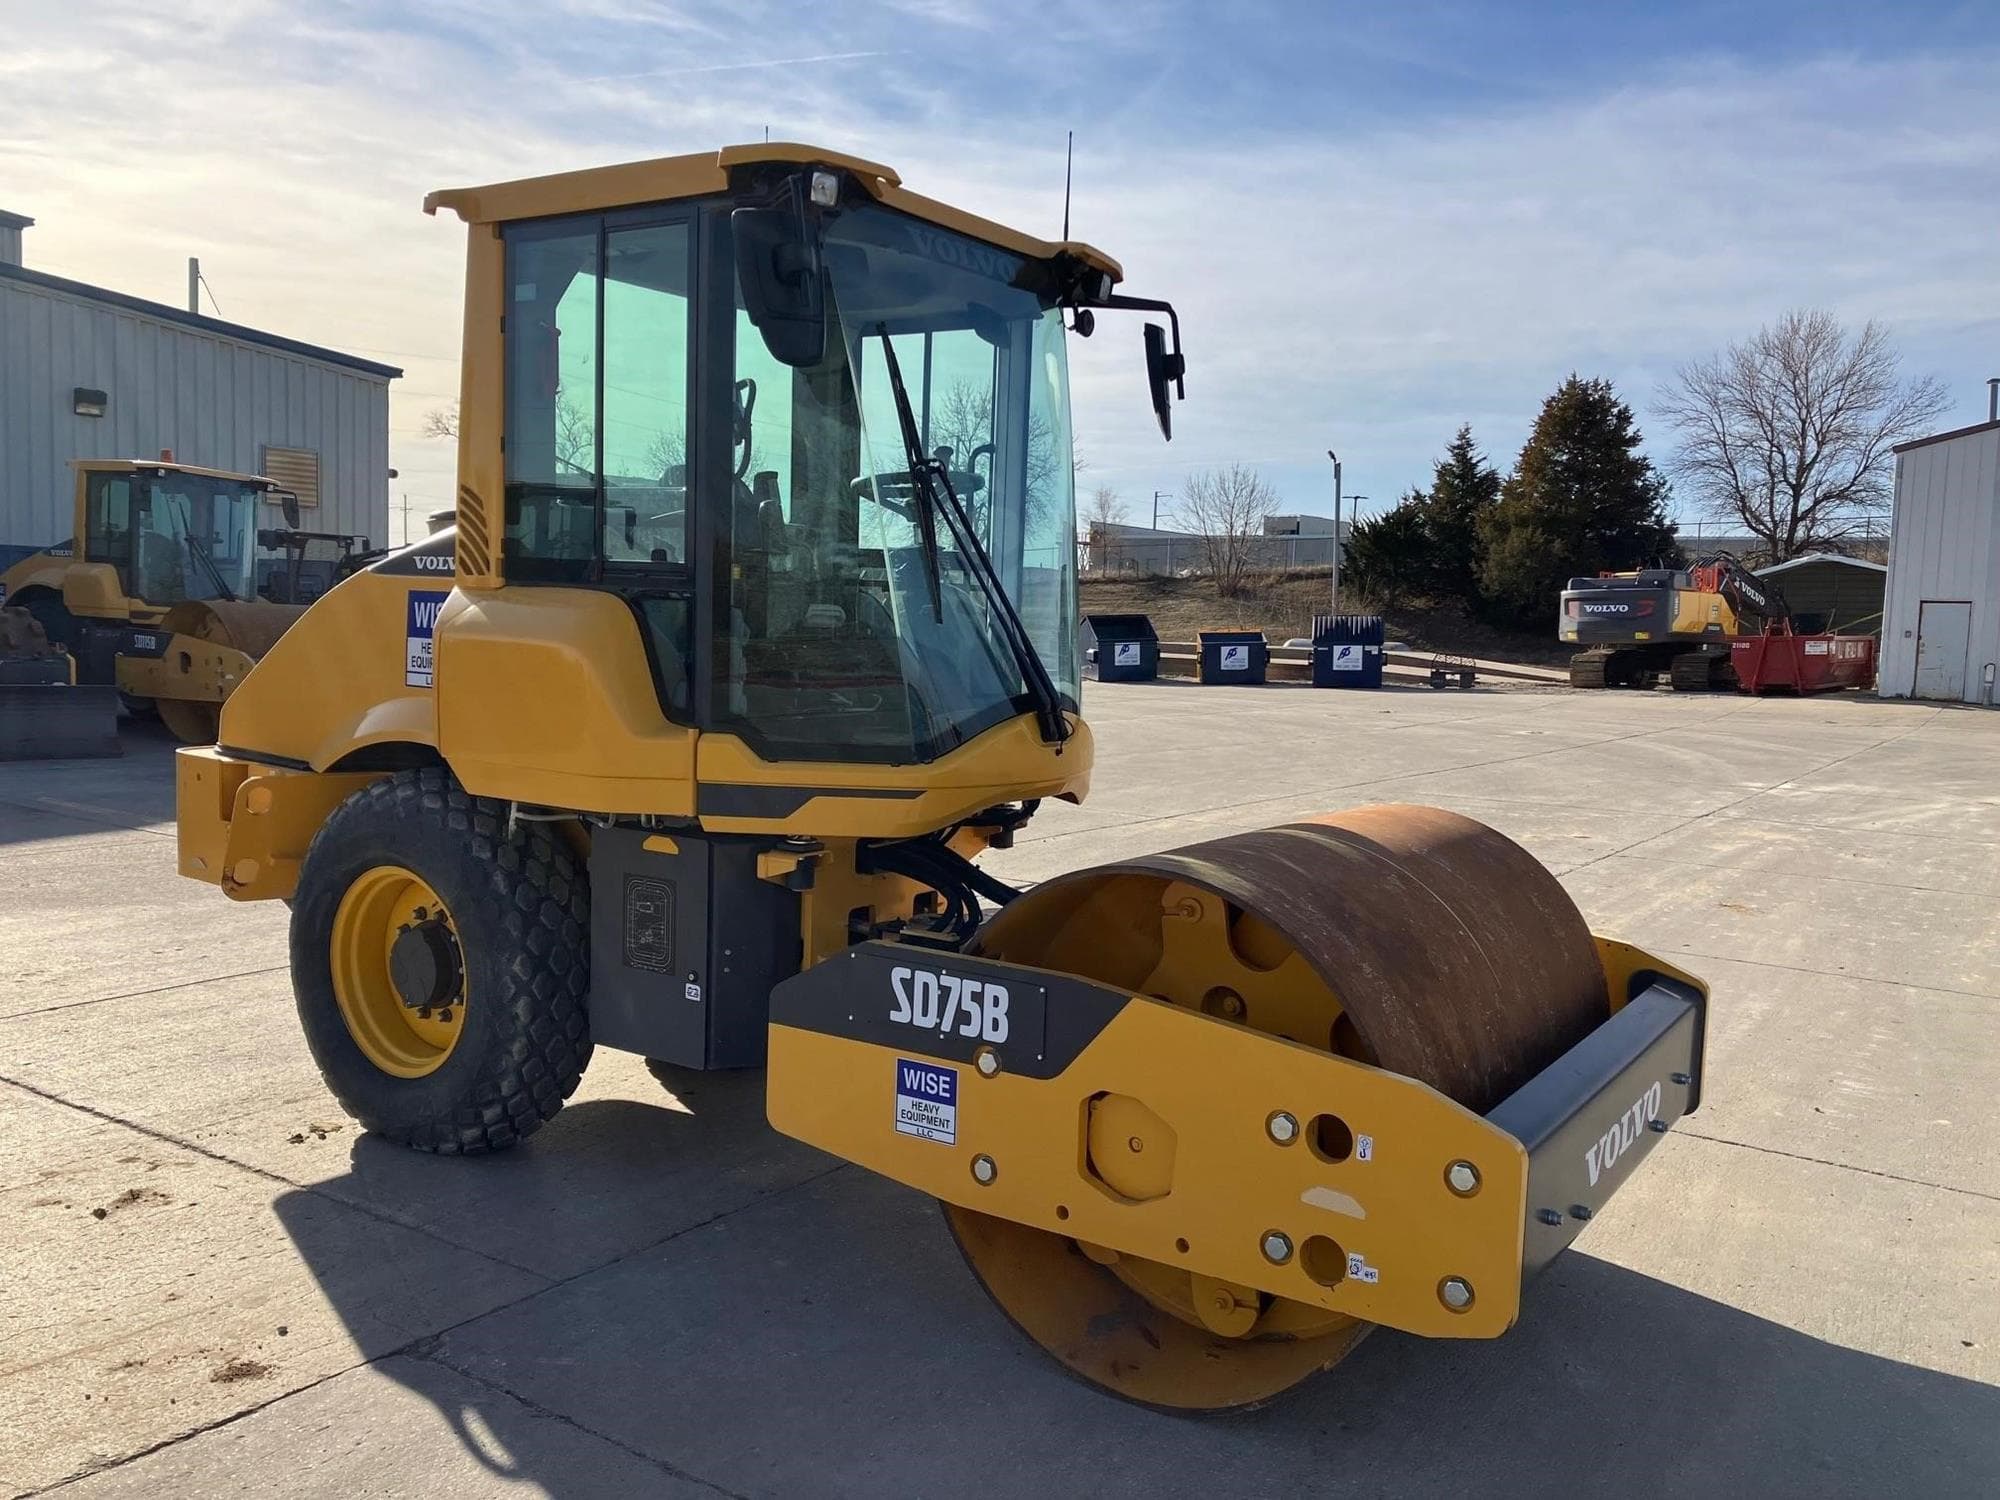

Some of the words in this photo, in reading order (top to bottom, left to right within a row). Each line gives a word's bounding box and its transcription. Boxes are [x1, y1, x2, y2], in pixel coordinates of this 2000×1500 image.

[413, 555, 456, 570] VOLV
[1741, 581, 1766, 606] VOLVO
[1584, 604, 1629, 613] VOLVO
[889, 966, 1009, 1044] SD75B
[903, 1067, 951, 1098] WISE
[911, 1100, 940, 1116] HEAVY
[900, 1109, 951, 1130] EQUIPMENT
[916, 1128, 934, 1139] LLC
[1585, 1081, 1661, 1187] VOLVO
